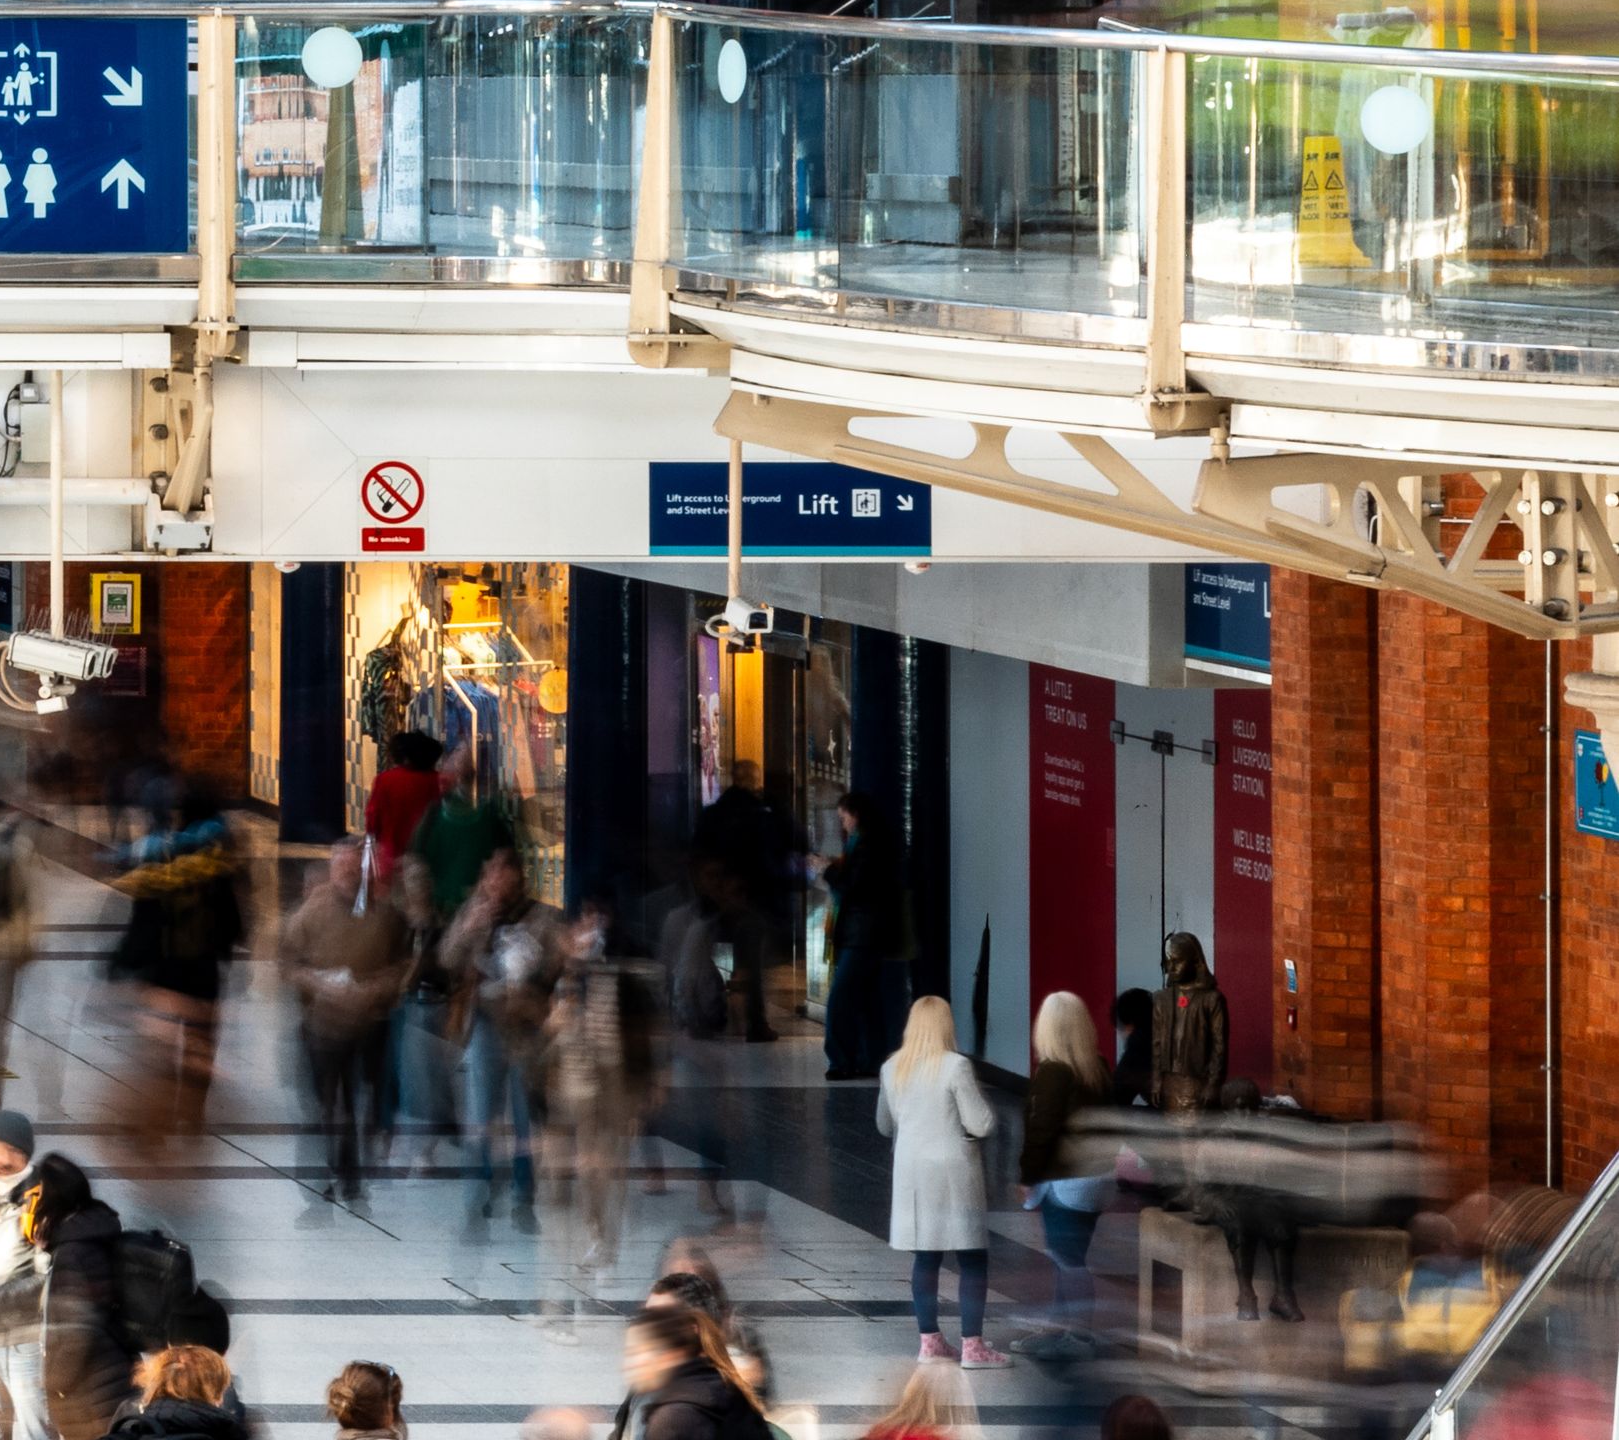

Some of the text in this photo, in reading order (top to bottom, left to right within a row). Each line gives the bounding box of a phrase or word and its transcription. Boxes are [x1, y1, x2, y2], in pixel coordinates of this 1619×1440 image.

[666, 494, 682, 503] Lift
[713, 495, 723, 503] to
[725, 494, 781, 506] Uerground
[666, 506, 682, 514] and
[684, 506, 711, 514] Street
[798, 493, 839, 515] Lift
[380, 536, 410, 544] smoking
[1045, 680, 1072, 700] A LITTLE
[1045, 705, 1087, 730] TREAT ON US
[1233, 719, 1256, 739] HELLO
[1233, 774, 1265, 798] STATION,
